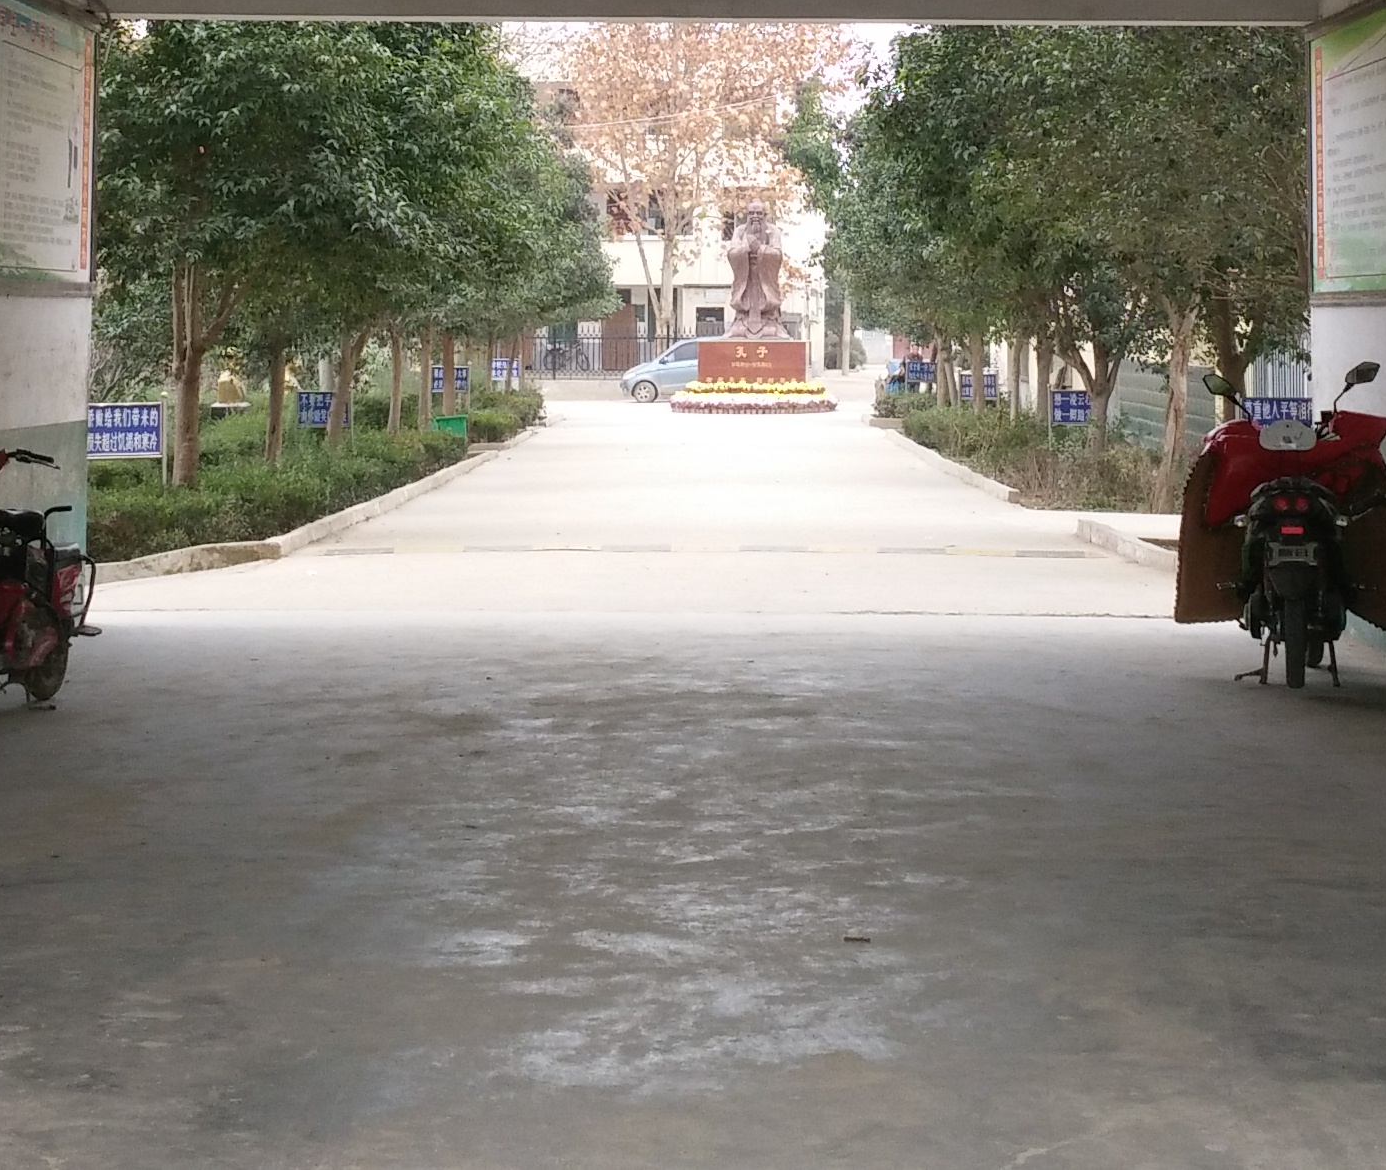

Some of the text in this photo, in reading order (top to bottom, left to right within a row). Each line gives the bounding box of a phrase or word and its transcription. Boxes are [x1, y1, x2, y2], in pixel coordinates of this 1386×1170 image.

[735, 345, 769, 359] 孔子
[300, 393, 333, 408] 不要把手
